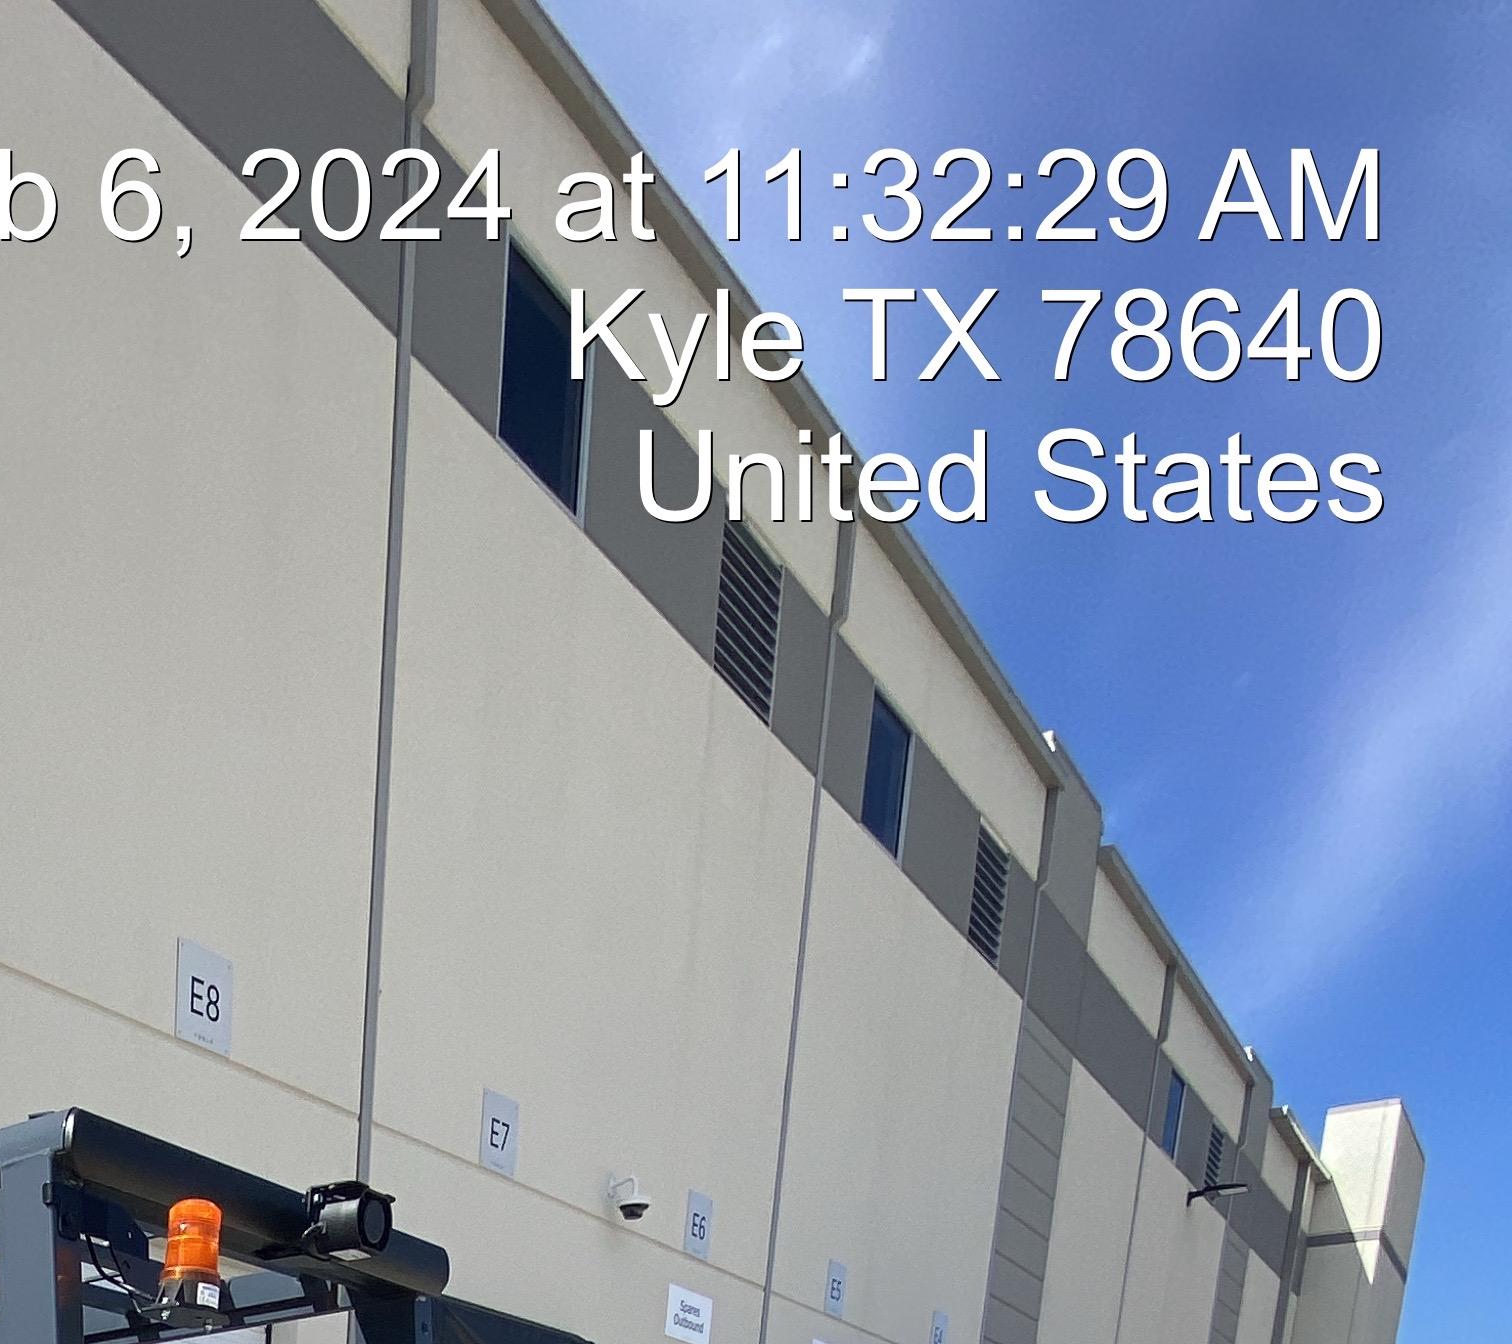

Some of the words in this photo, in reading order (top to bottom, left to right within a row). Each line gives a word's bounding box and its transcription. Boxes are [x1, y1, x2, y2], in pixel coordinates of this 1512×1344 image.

[190, 975, 220, 1022] E8
[489, 1117, 510, 1152] E7
[691, 1212, 706, 1240] E6
[830, 1278, 841, 1301] E5
[679, 1299, 701, 1318] Spares
[673, 1313, 705, 1334] Outbound
